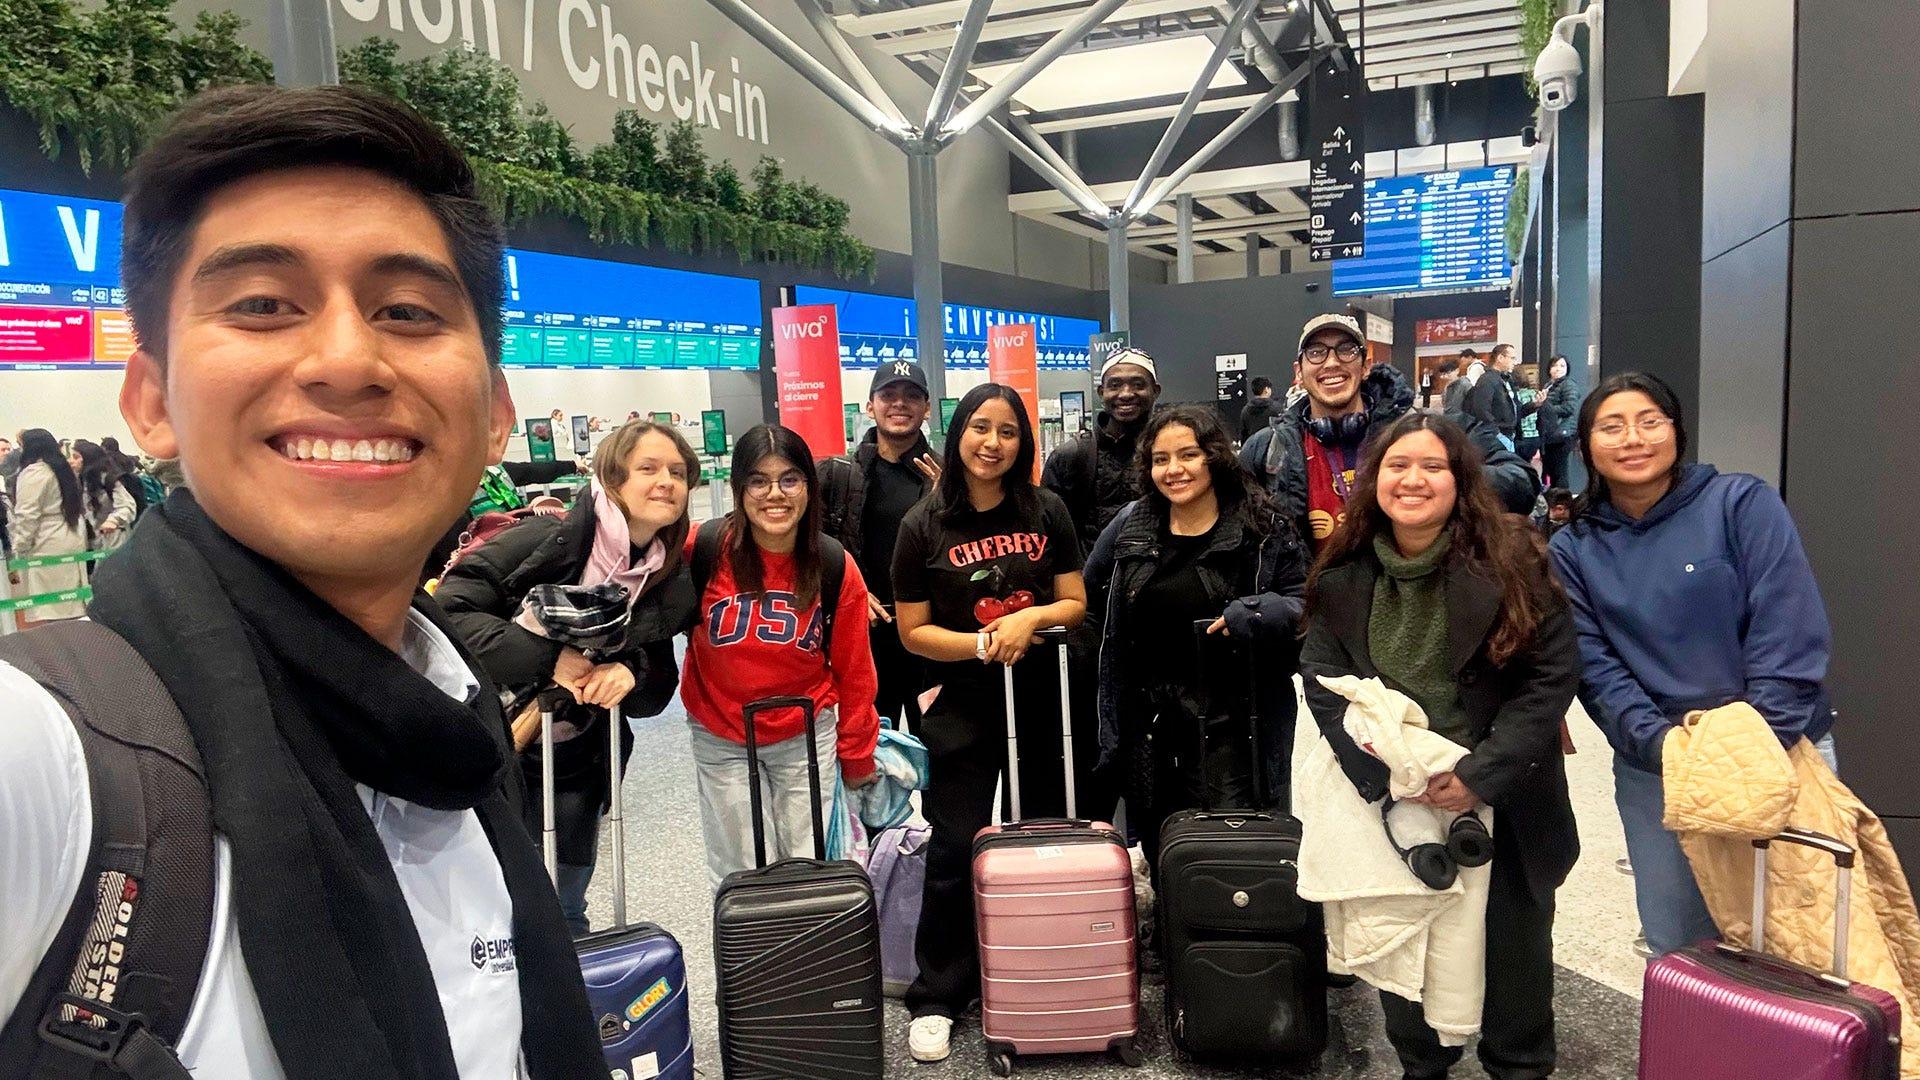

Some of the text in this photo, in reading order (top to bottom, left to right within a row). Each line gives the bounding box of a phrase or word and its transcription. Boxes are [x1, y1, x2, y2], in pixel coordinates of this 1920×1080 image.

[558, 0, 769, 145] Check-in
[1311, 228, 1335, 237] Prepago
[1311, 236, 1333, 244] Prepaid
[783, 381, 825, 391] Próximos
[784, 392, 819, 401] al cierre
[948, 532, 1048, 568] CHERRY
[707, 589, 823, 654] USA
